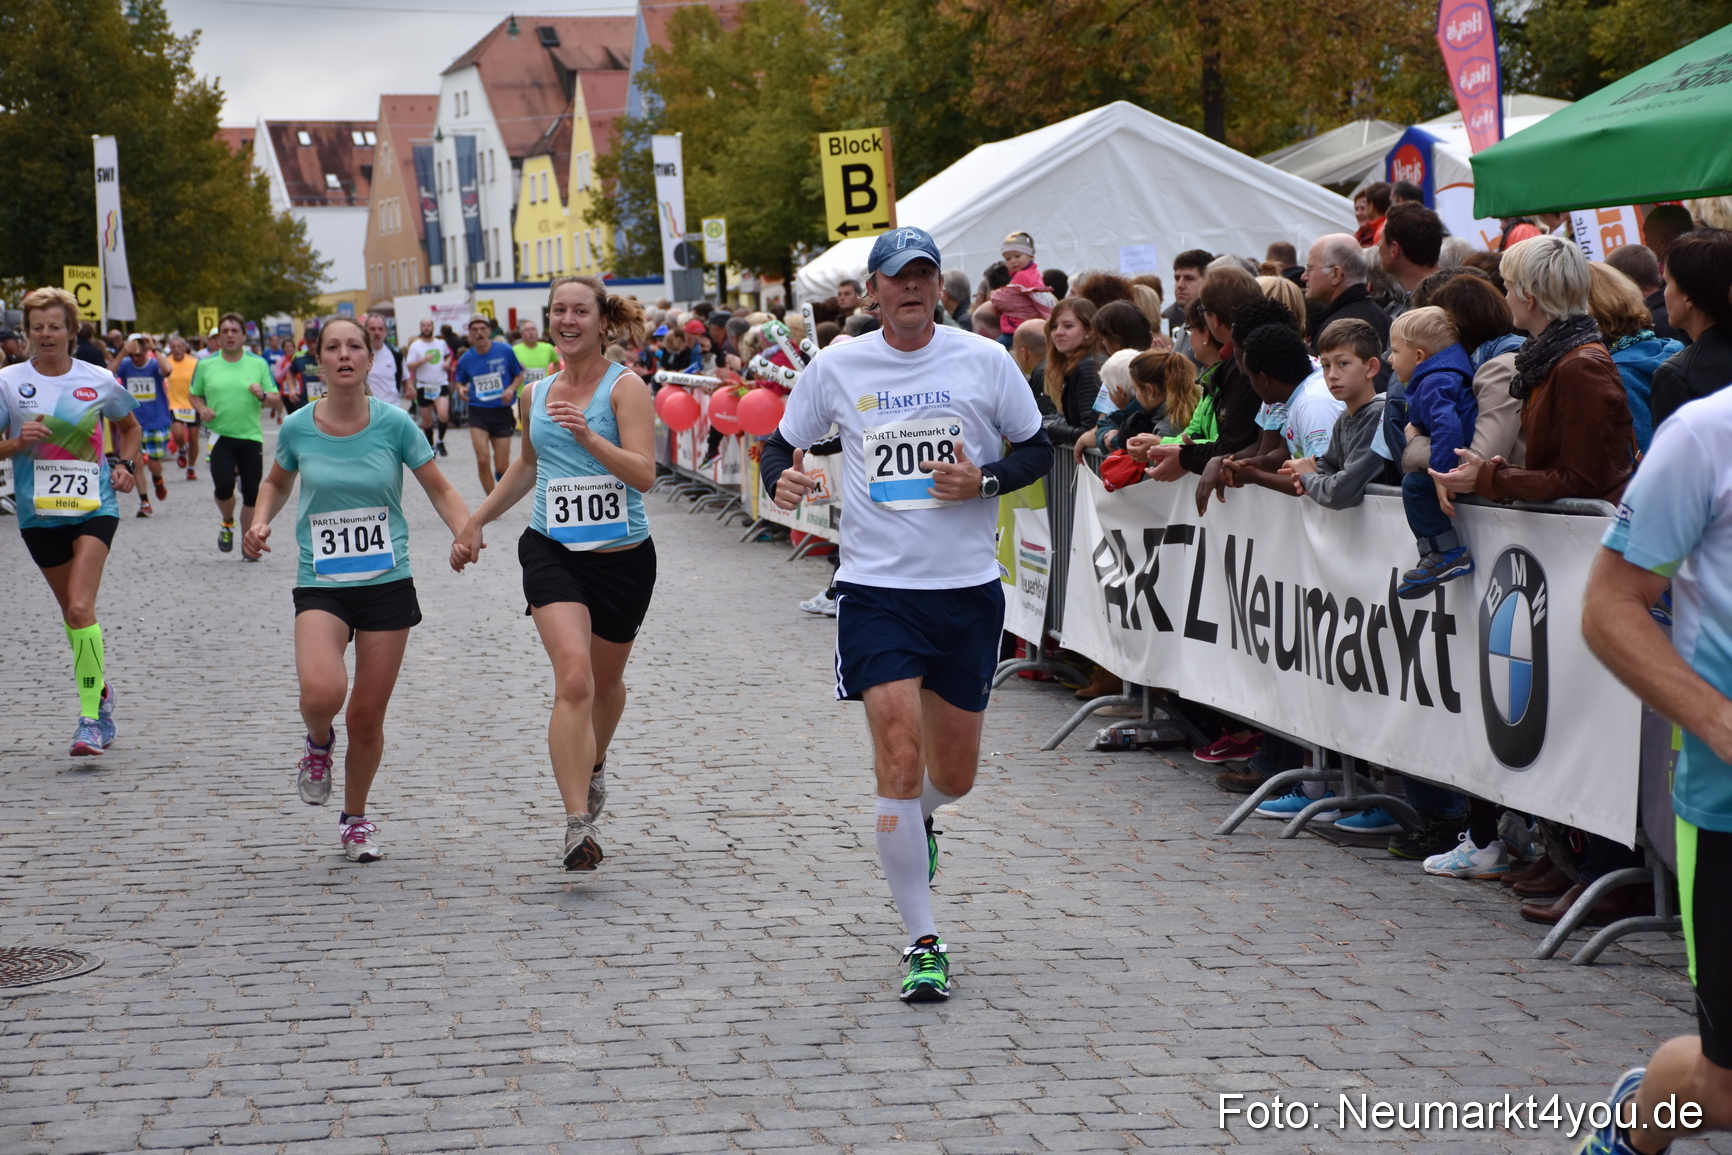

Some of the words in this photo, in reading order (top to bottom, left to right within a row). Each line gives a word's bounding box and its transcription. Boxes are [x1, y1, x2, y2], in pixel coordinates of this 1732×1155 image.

[828, 133, 884, 156] Block
[841, 163, 878, 216] B
[68, 268, 97, 279] Block
[74, 283, 92, 308] C
[203, 316, 214, 330] D
[76, 390, 96, 398] Hervis
[133, 384, 150, 394] 314
[477, 379, 500, 391] 2238
[876, 390, 951, 411] HÄRTEIS
[865, 430, 898, 442] PARTL
[899, 427, 946, 439] Neumarkt
[874, 439, 956, 478] 2008
[36, 464, 59, 472] PARTL
[60, 465, 90, 473] Neumarkt
[48, 474, 88, 496] 273
[548, 484, 572, 493] PARTL
[574, 482, 613, 491] Neumarkt
[55, 499, 79, 508] Heidi
[554, 492, 620, 523] 3103
[312, 518, 338, 527] PARTL
[340, 514, 376, 525] Neumarkt
[320, 524, 385, 556] 3104
[1486, 553, 1547, 627] BMW
[1224, 534, 1462, 714] Neumarkt
